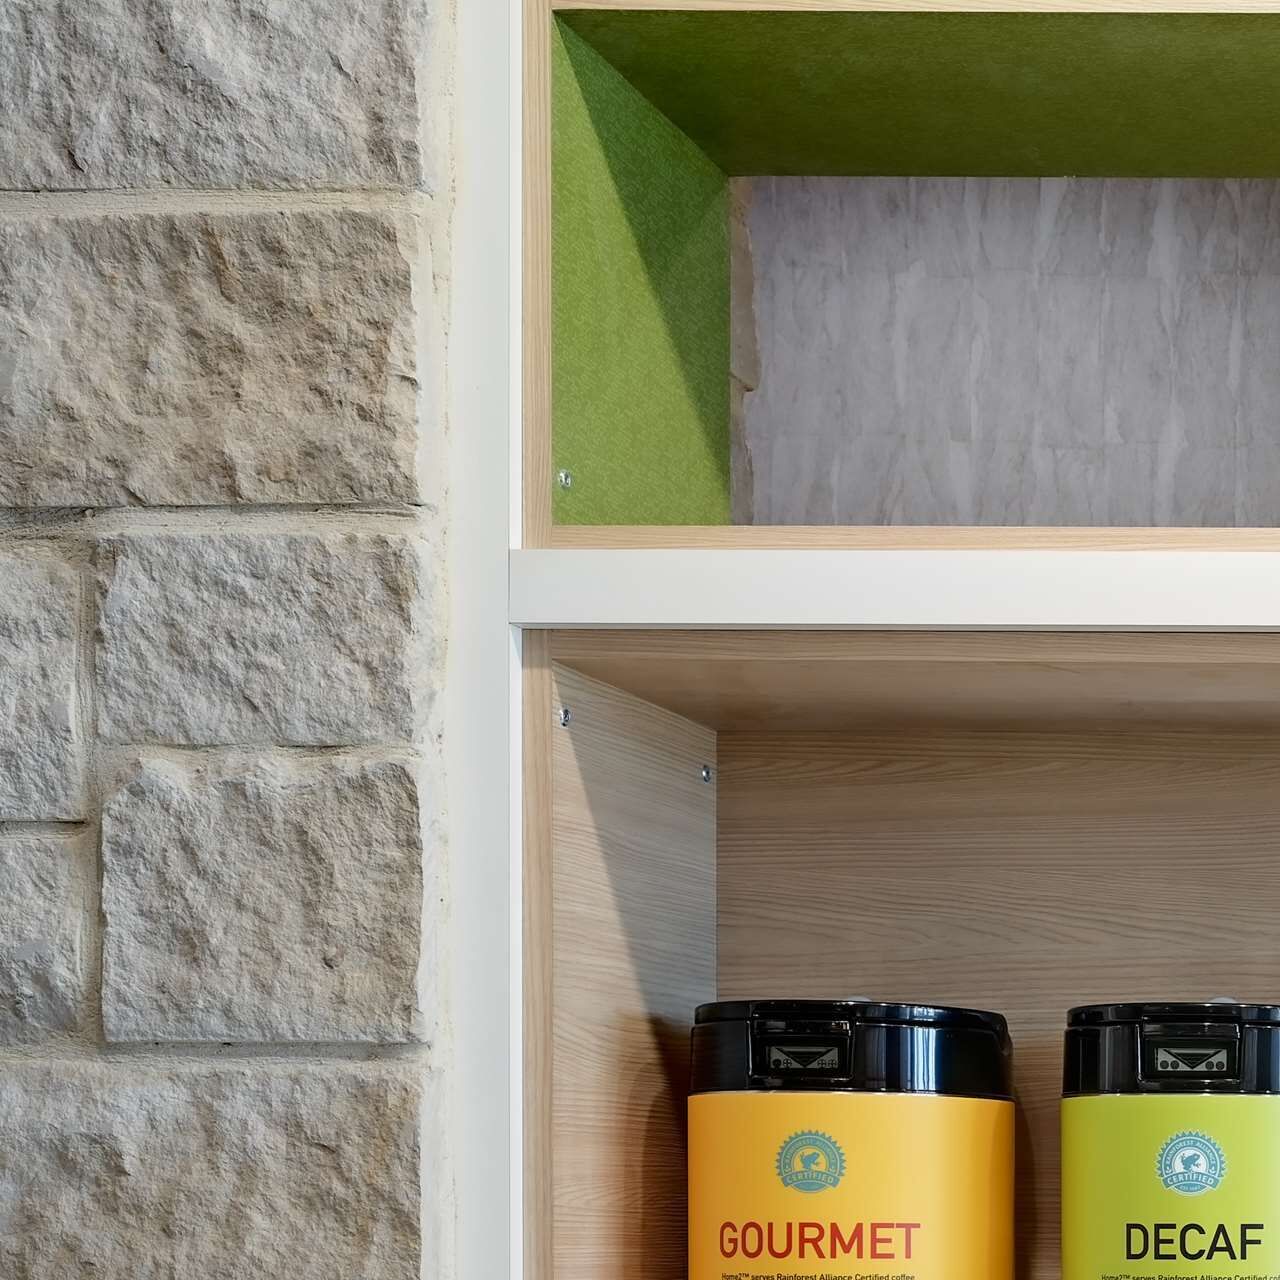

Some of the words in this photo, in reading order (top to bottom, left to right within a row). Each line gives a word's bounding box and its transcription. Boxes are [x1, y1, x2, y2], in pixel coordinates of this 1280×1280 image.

[786, 1172, 834, 1184] CERTIFIED
[1167, 1173, 1214, 1185] CERTIFIED
[720, 1221, 921, 1259] GOURMET
[1126, 1223, 1264, 1260] DECAF
[777, 1273, 817, 1280] Rainforest
[819, 1273, 853, 1280] Alliance
[855, 1273, 890, 1280] Certified
